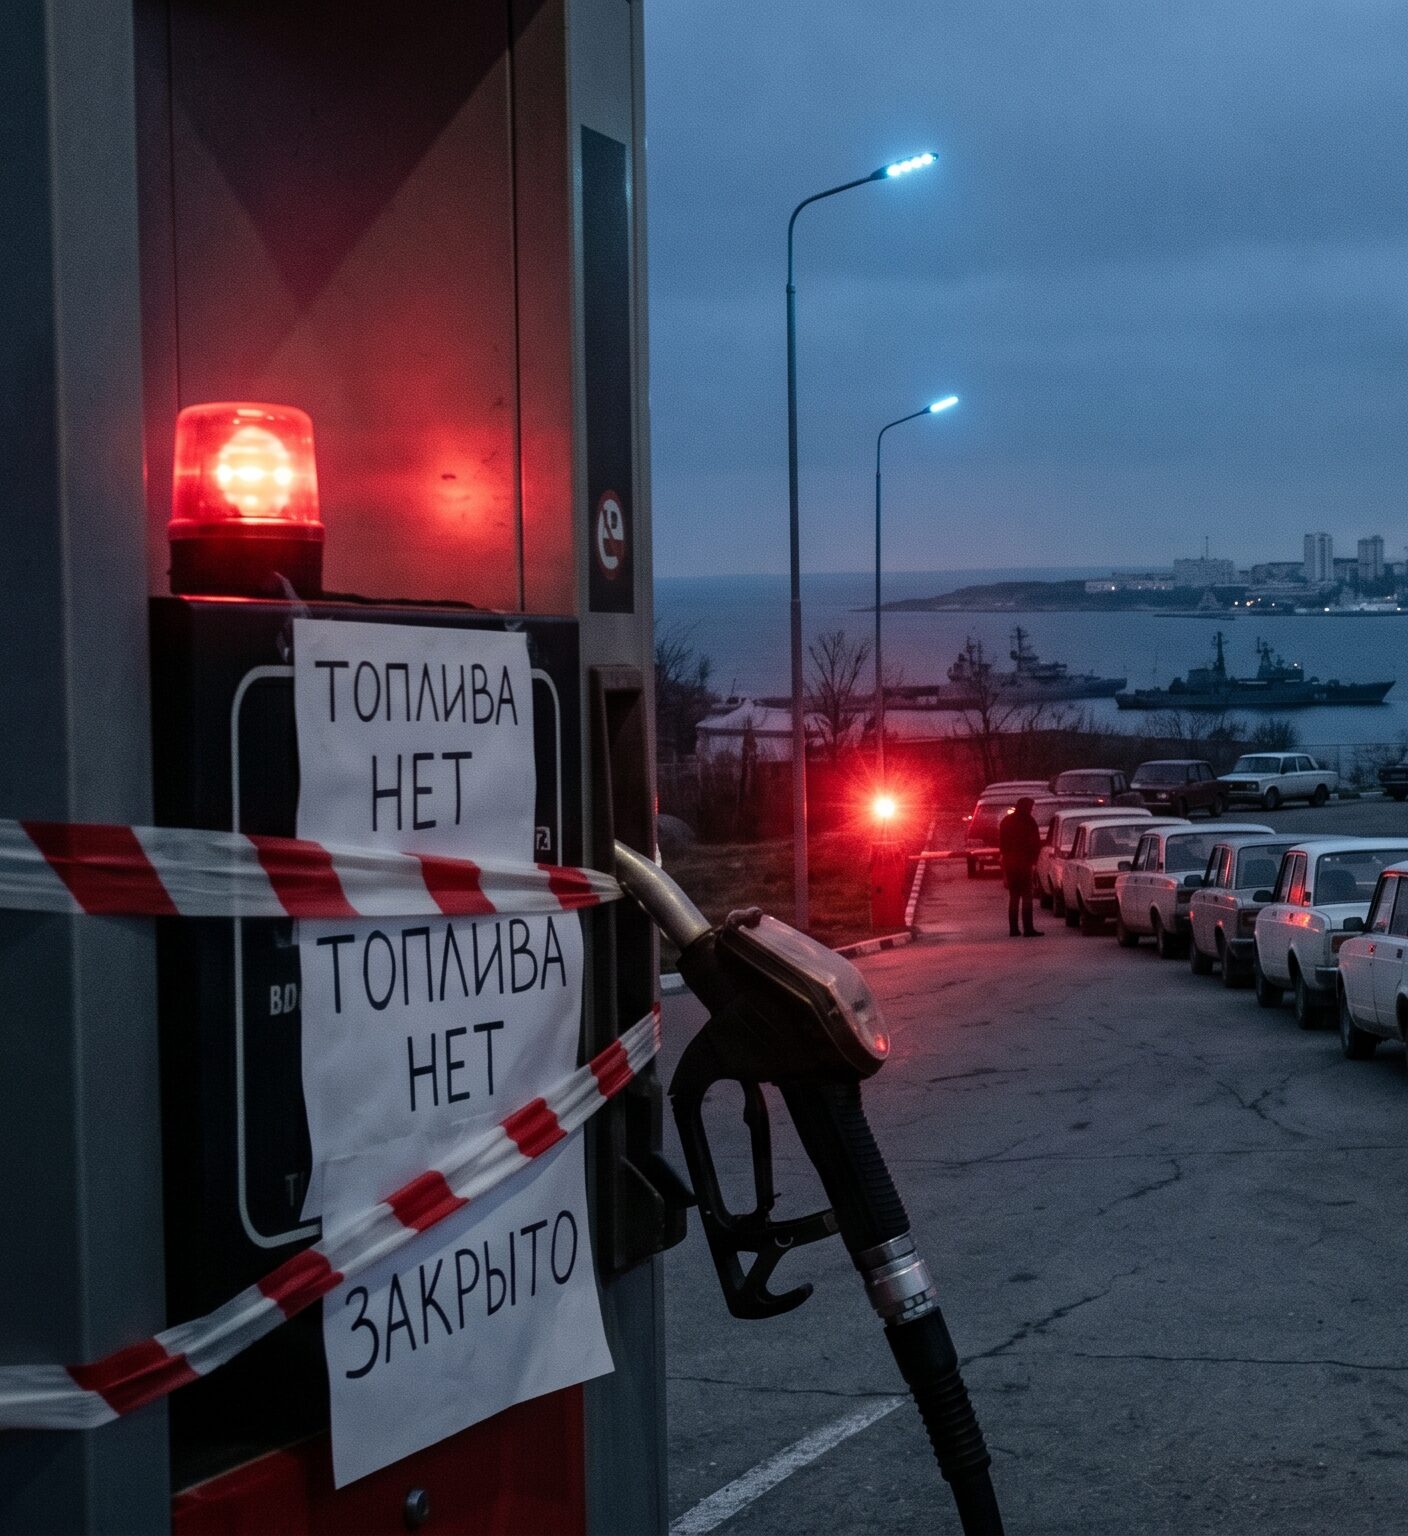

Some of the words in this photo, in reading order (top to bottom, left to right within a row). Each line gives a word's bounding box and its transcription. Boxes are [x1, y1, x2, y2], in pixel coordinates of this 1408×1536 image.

[315, 660, 520, 726] ТОПЛИВА
[371, 750, 474, 832] НЕТ
[316, 915, 569, 1015] ТОПЛИВА
[407, 1020, 506, 1113] НЕТ
[344, 1209, 580, 1380] ЗАКРЫТО
